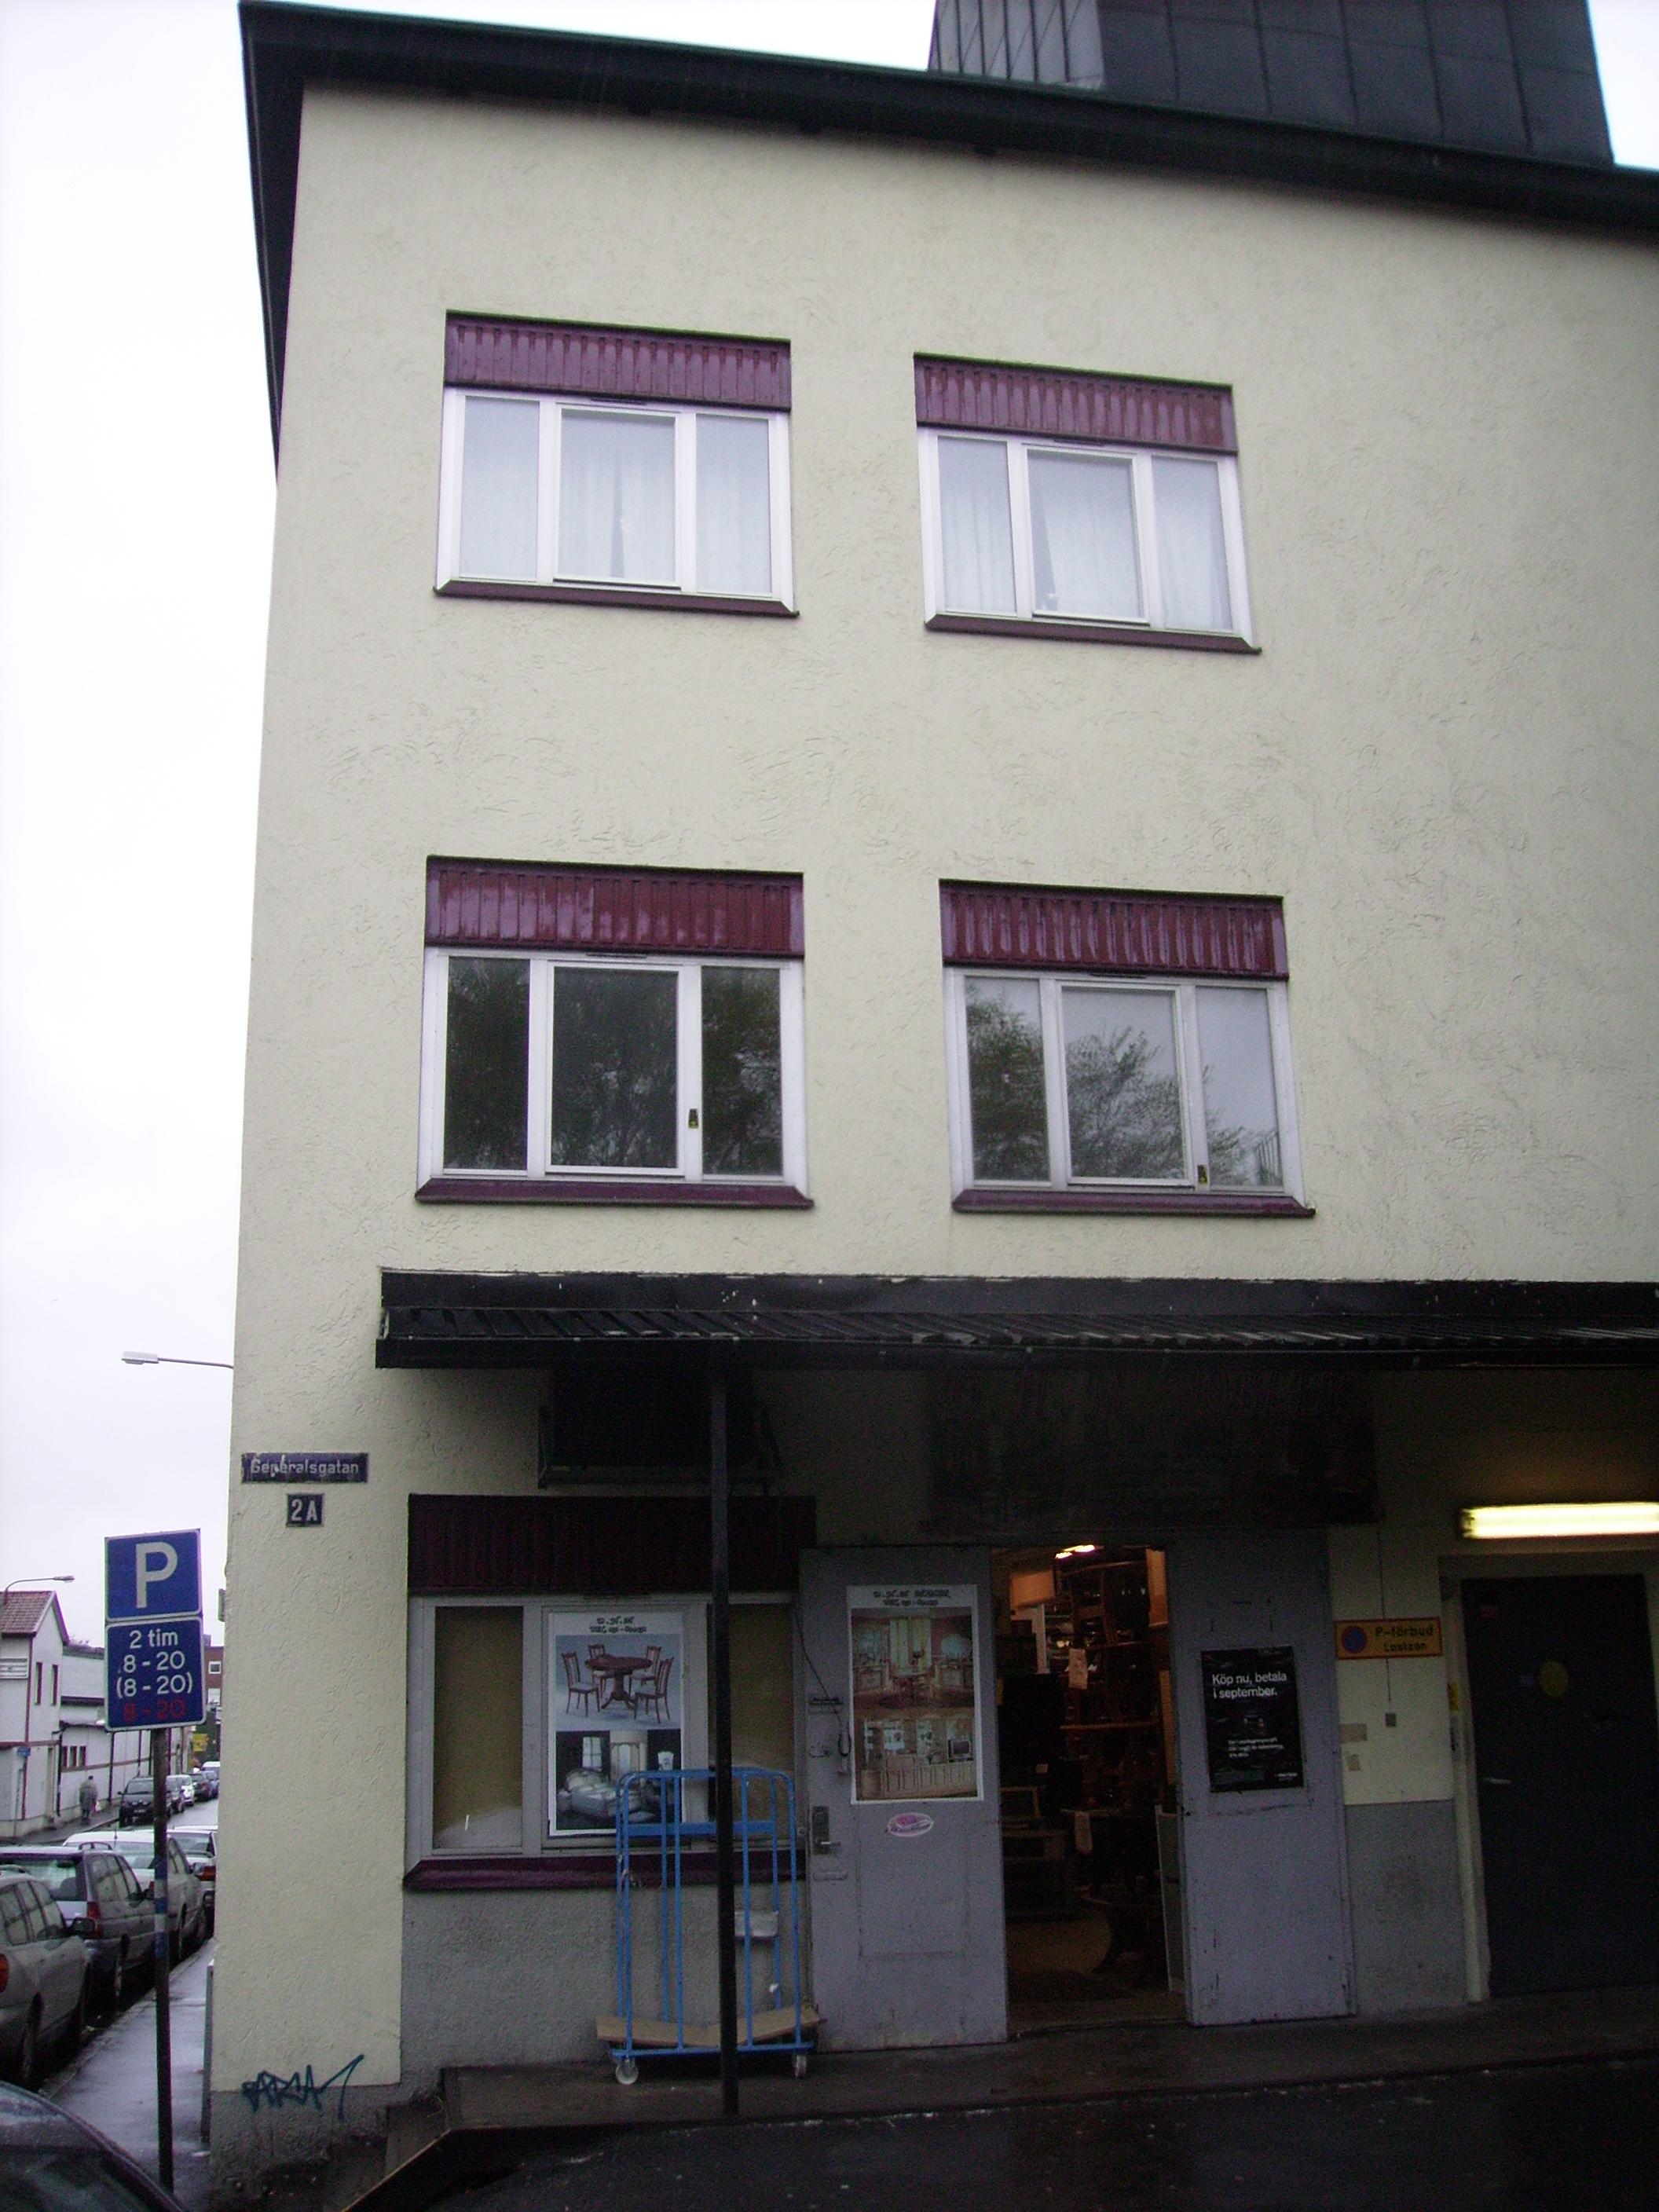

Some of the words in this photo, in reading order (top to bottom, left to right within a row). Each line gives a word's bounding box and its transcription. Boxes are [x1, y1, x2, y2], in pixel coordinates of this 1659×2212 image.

[250, 1457, 360, 1477] Generalsgatan
[135, 1540, 178, 1609] P
[129, 1630, 141, 1649] 2
[148, 1628, 178, 1647] tim
[1212, 1673, 1233, 1686] Köp
[1236, 1675, 1253, 1686] nu,
[1254, 1671, 1287, 1683] betala
[1213, 1687, 1218, 1699] i
[1219, 1685, 1278, 1700] september.
